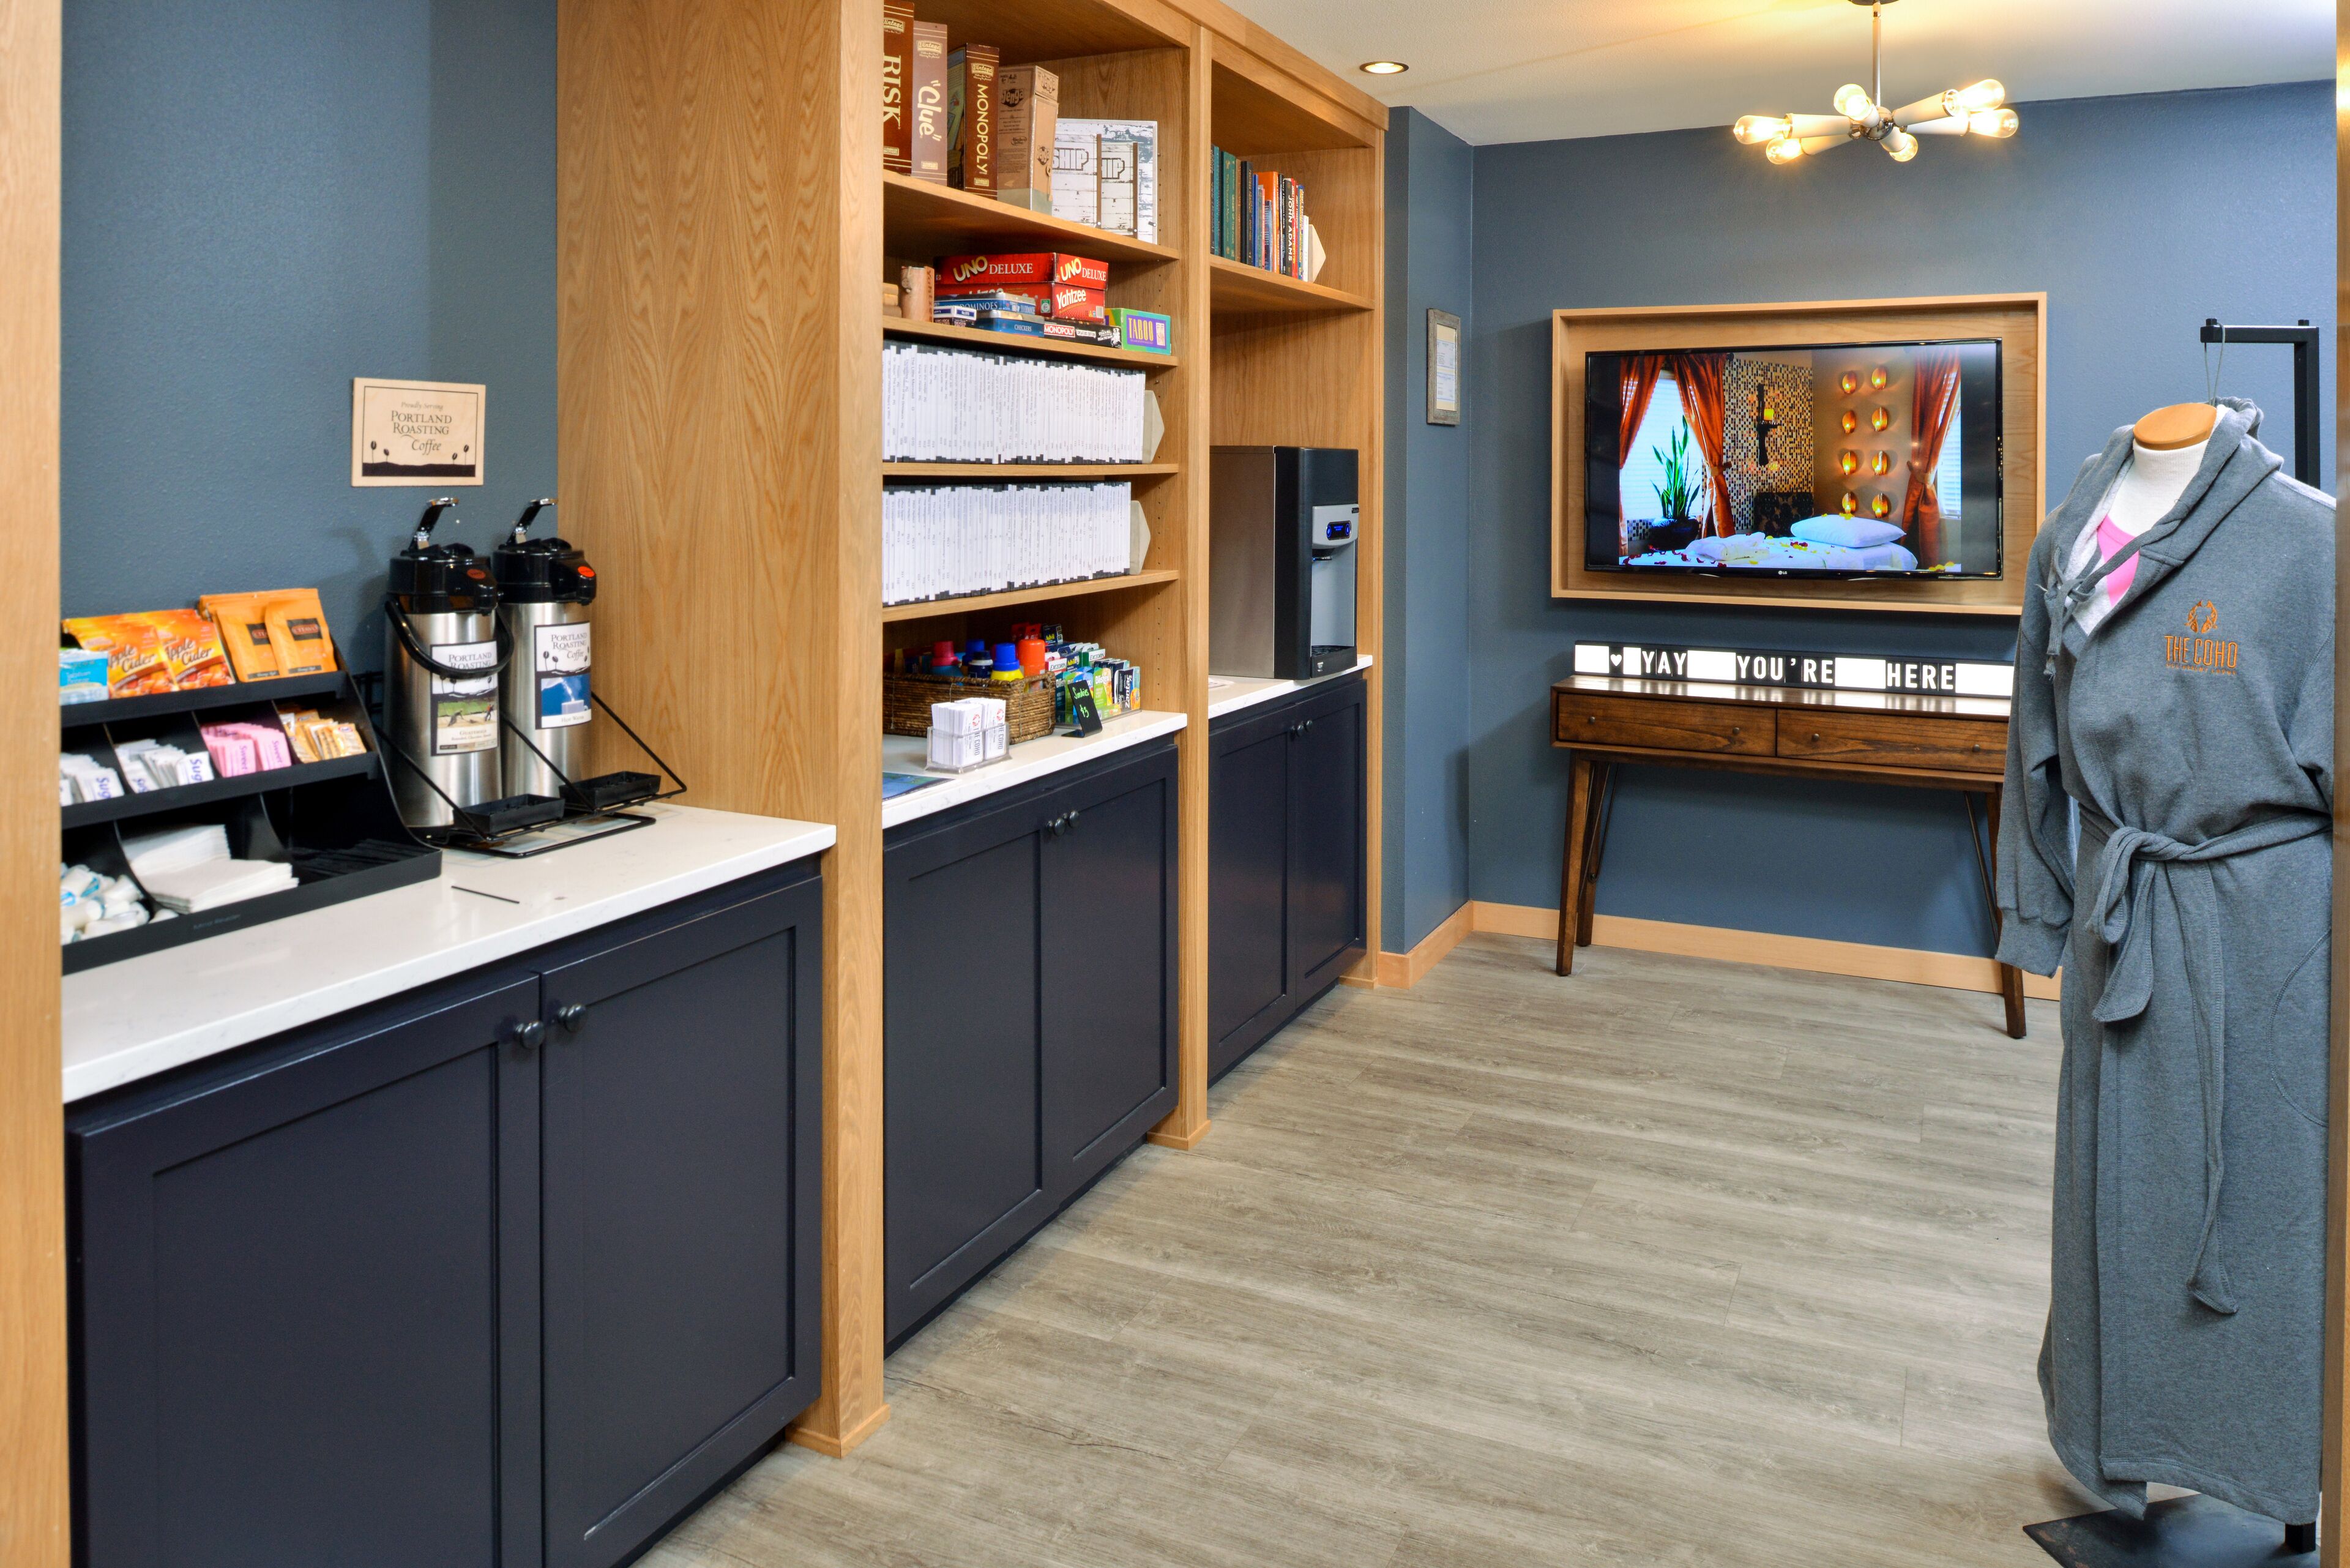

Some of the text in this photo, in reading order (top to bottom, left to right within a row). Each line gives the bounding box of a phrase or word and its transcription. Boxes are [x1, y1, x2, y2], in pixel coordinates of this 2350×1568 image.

[920, 42, 941, 51] Vintage
[883, 55, 901, 127] RISK
[1001, 88, 1025, 105] Jenga
[977, 83, 989, 175] MONOPOLY
[953, 256, 1033, 282] UNO DELUXE
[1060, 258, 1106, 282] UNO DELUXE
[1056, 289, 1086, 310] Yahtzee
[1014, 324, 1032, 332] CHECKERS
[1044, 325, 1074, 335] MONOPOLY
[1128, 318, 1154, 342] TABOO
[423, 403, 444, 411] Serving
[391, 410, 452, 424] PORTLAND
[393, 422, 449, 435] ROASTING
[411, 439, 441, 455] Coffee
[551, 632, 588, 643] PORTLAND
[181, 647, 214, 666] Cider
[449, 652, 492, 663] PORTLAND
[567, 650, 584, 661] Coffee
[2165, 635, 2239, 668] THE COHO
[122, 654, 158, 673] Cider
[1642, 651, 1954, 690] YAY YOU'RE HERE
[1095, 675, 1110, 684] Blistex
[1072, 687, 1089, 700] Sundries
[1080, 704, 1089, 719] $3
[272, 740, 282, 763] Sweet
